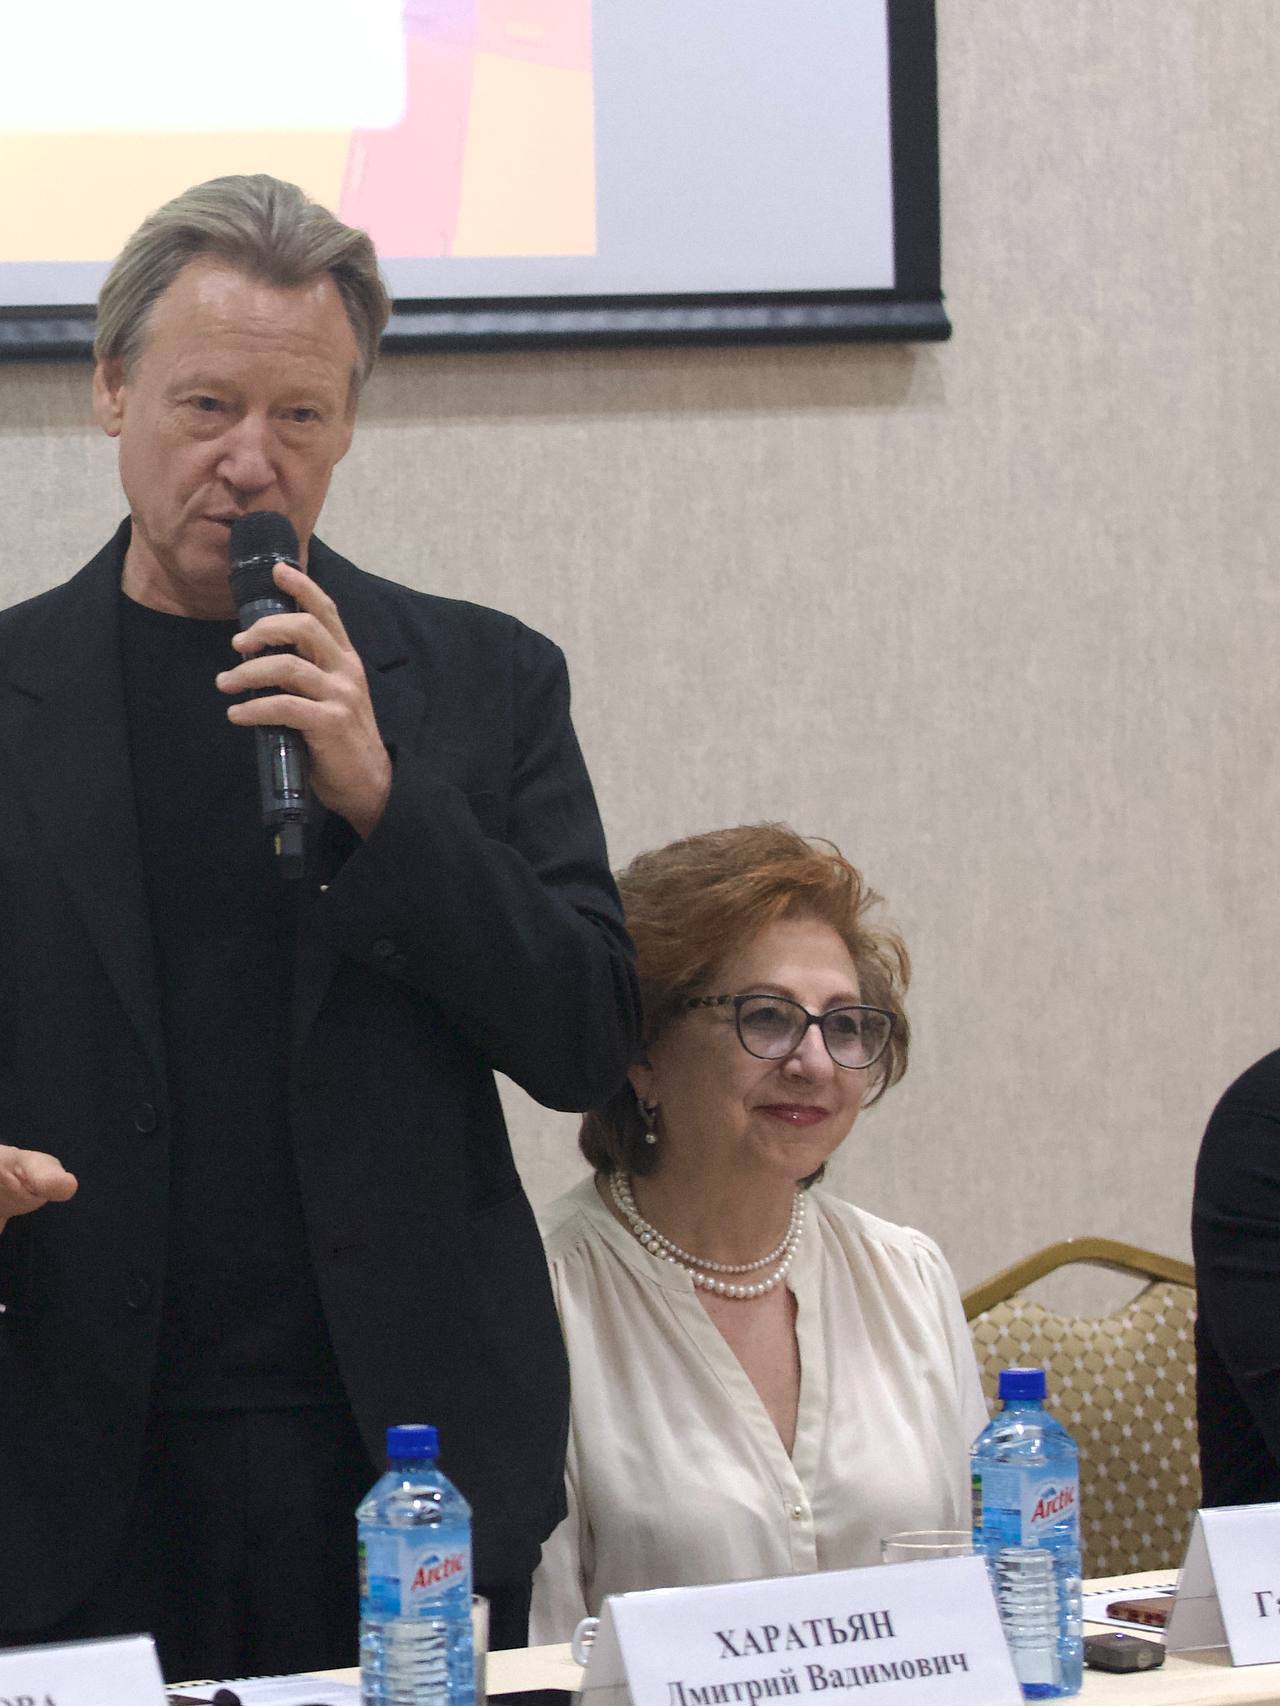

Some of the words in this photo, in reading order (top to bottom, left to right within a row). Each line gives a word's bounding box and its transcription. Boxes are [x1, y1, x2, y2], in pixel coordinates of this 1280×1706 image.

[1031, 1486, 1075, 1522] Arctic
[410, 1553, 464, 1592] Arctic
[713, 1609, 896, 1659] ХАРАТЬЯН
[666, 1667, 801, 1706] Дмитрий
[804, 1652, 969, 1692] Вадимович
